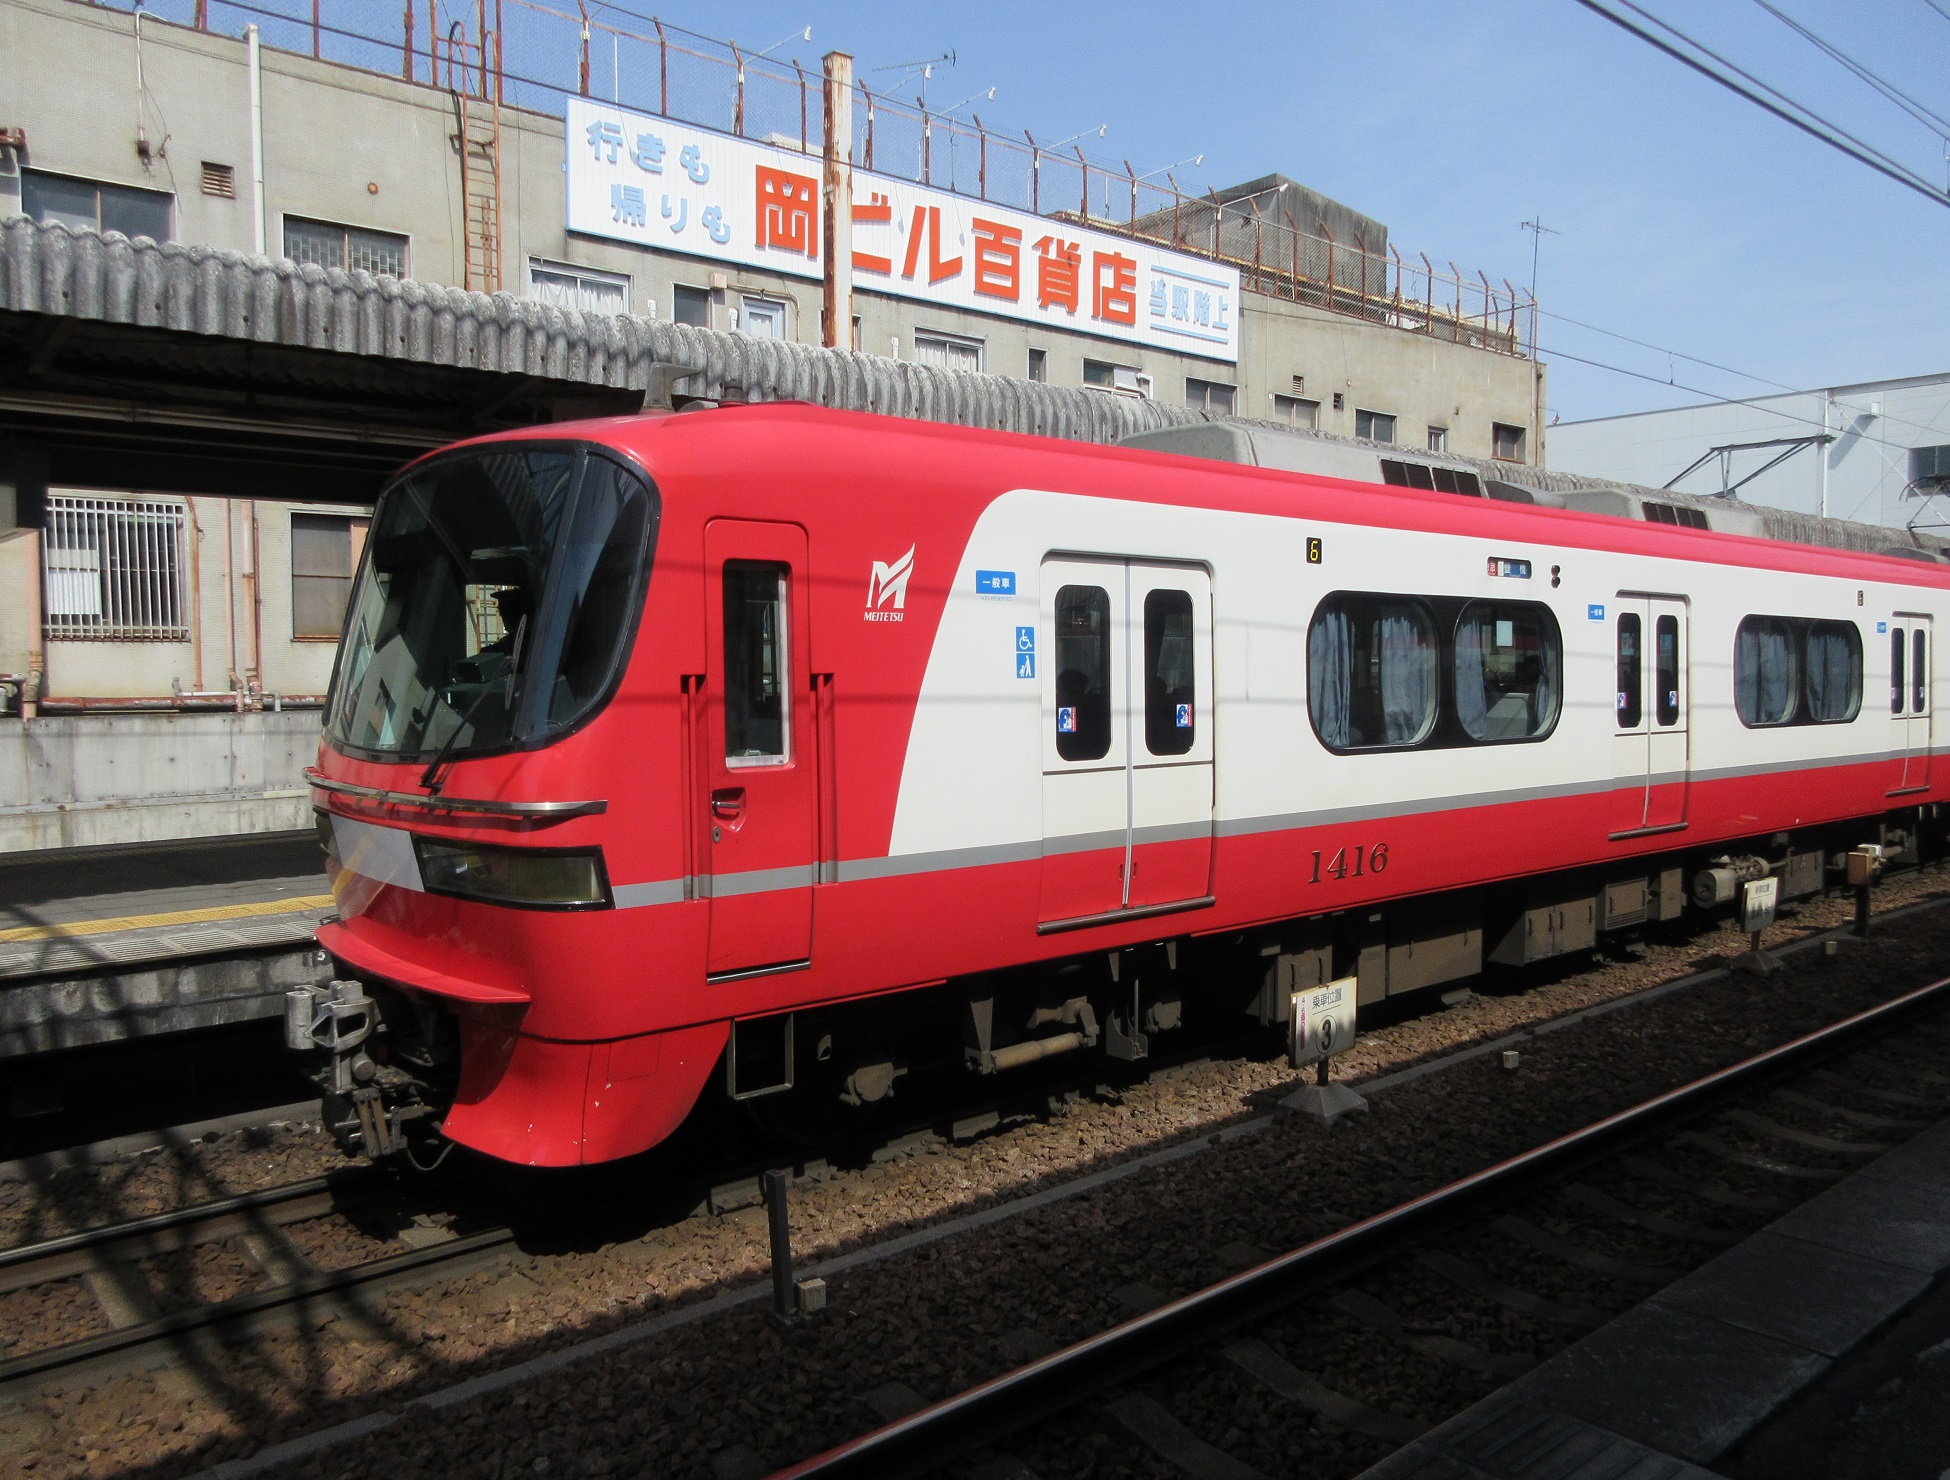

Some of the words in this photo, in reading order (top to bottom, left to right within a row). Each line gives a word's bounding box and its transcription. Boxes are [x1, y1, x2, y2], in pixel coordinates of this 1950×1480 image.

[586, 120, 710, 184] 行きも
[610, 183, 731, 244] 帰りも
[755, 164, 1137, 325] 岡ビル百貨店
[1149, 278, 1229, 330] 当駅階上
[1310, 540, 1318, 561] 6
[981, 577, 1010, 589] 一般車
[863, 611, 904, 622] MEITETSU
[1308, 842, 1388, 884] 1416
[1312, 987, 1342, 1010] 乗車位置
[1321, 1019, 1332, 1051] 3
